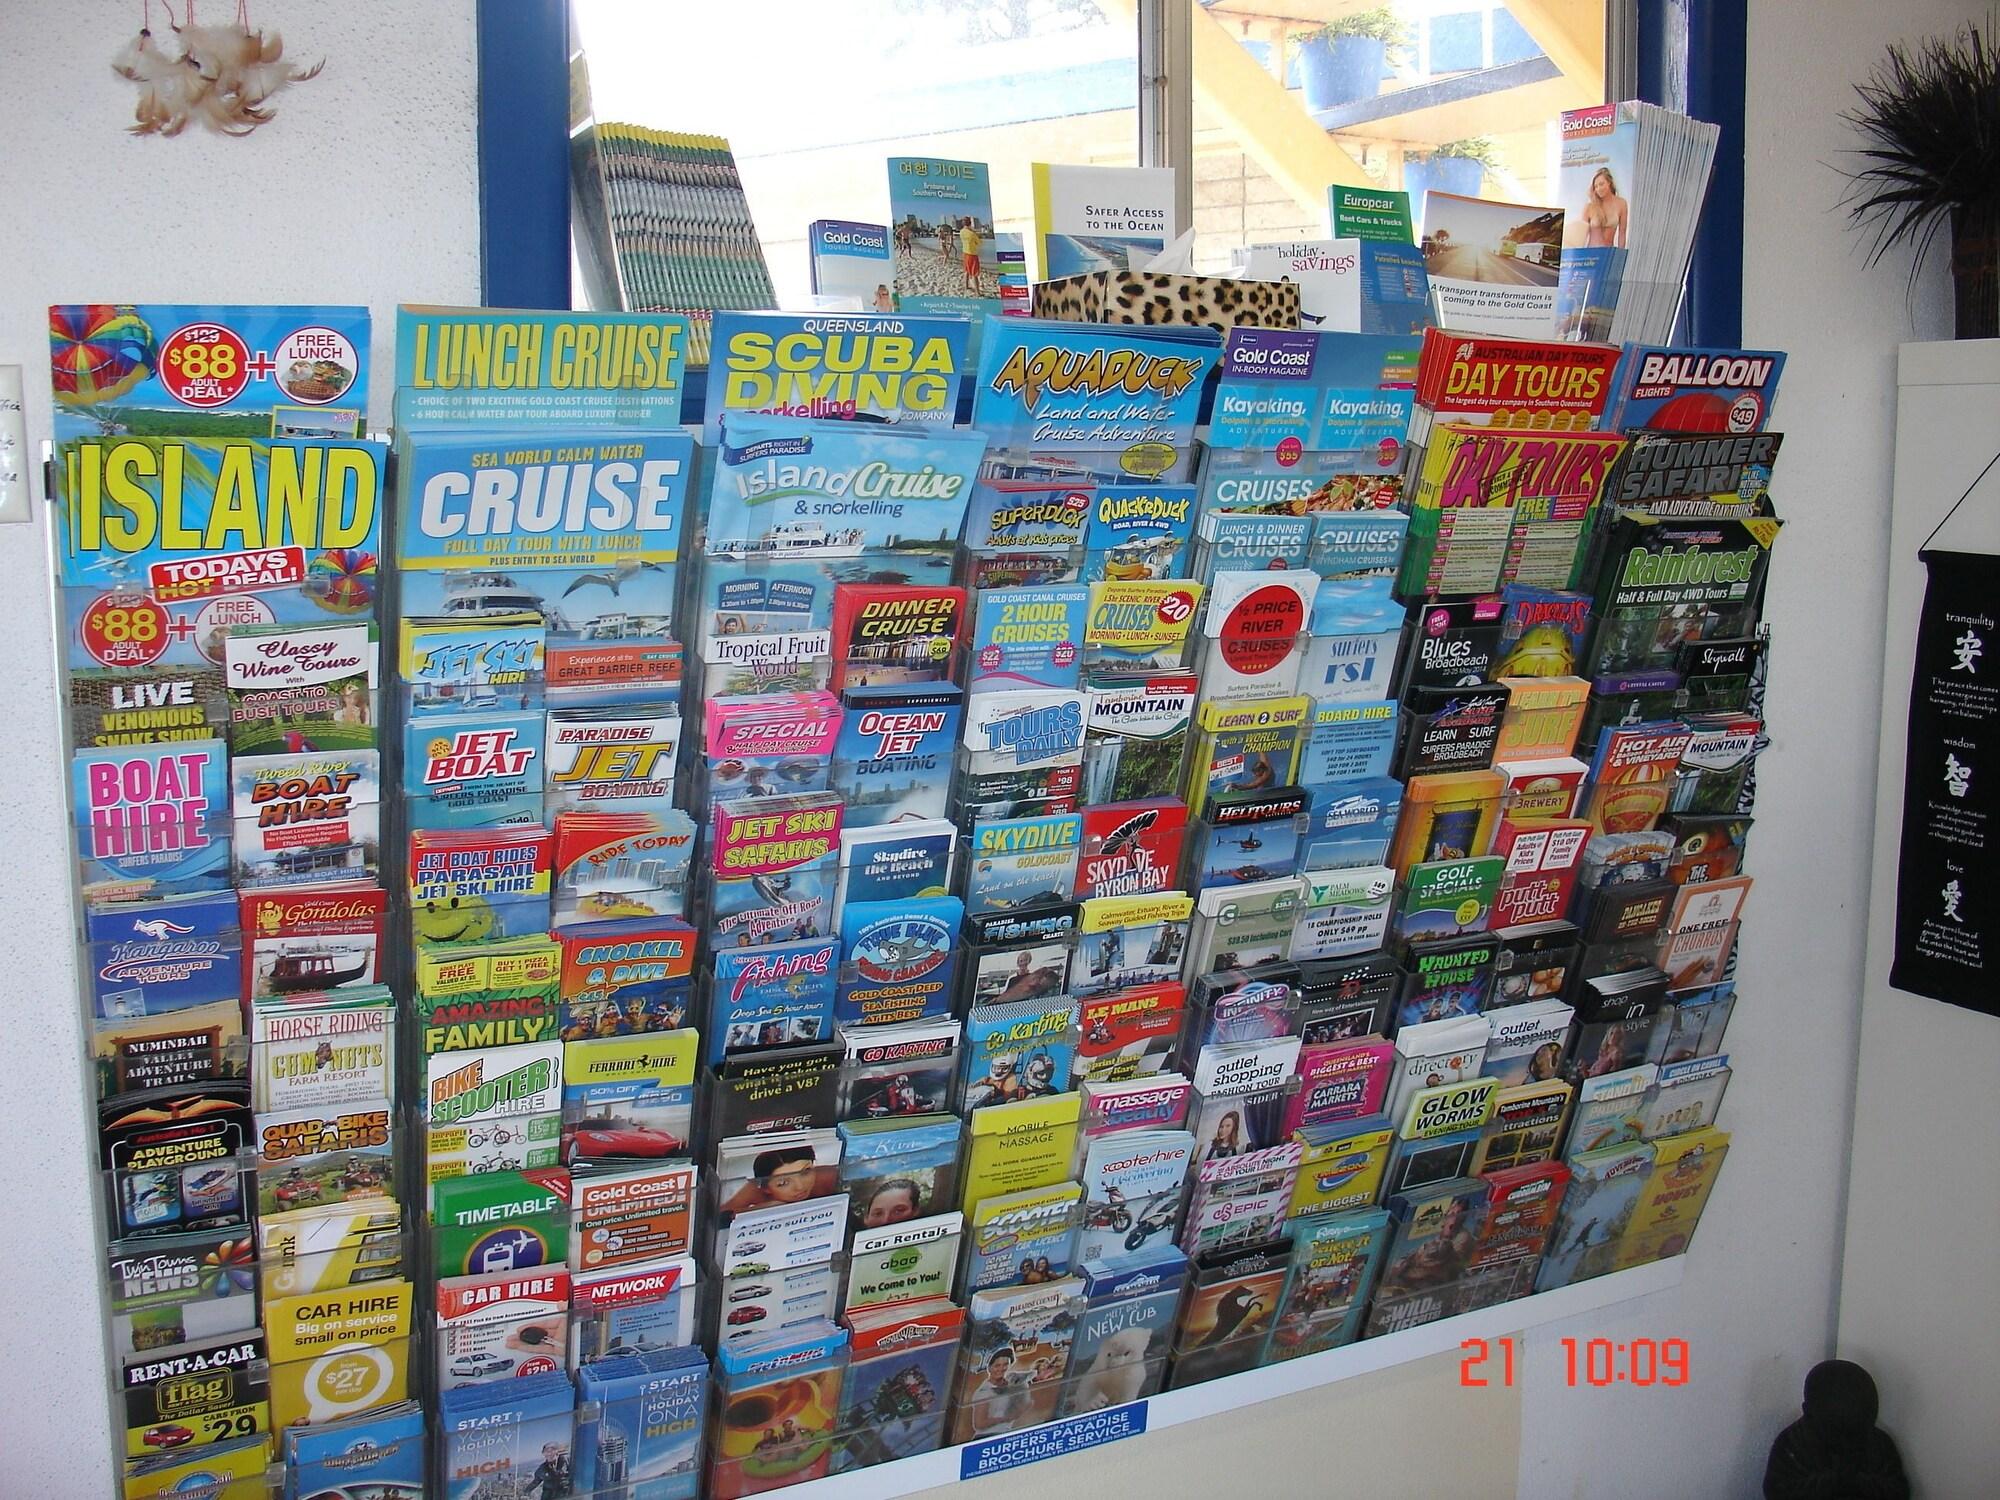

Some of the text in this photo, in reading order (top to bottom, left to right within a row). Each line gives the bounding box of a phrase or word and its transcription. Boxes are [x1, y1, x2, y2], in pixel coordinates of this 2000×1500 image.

[1561, 114, 1612, 132] Gold Coast
[900, 162, 976, 179] 여행 가이드
[1344, 194, 1394, 210] Europcar
[824, 232, 883, 248] Gold Coast
[1278, 245, 1318, 260] holiday
[1292, 252, 1355, 274] savings
[1430, 283, 1437, 291] A
[1439, 285, 1477, 299] transport
[1479, 288, 1541, 302] transformation
[1444, 296, 1474, 308] coming
[1488, 299, 1501, 307] the
[1504, 301, 1523, 309] Gold
[1525, 301, 1552, 310] Coast
[803, 320, 904, 333] QUEENSLAND
[296, 335, 336, 347] FREE
[170, 344, 236, 379] $88
[289, 347, 342, 359] LUNCH
[414, 323, 682, 390] LUNCH CRUISE
[726, 332, 954, 373] SCUBA
[1233, 348, 1310, 366] Gold Coast
[1446, 362, 1605, 399] DAY TOURS
[1640, 357, 1772, 387] BALLOON
[725, 372, 947, 410] DIVING
[1636, 387, 1671, 398] FLIGHTS
[1036, 404, 1175, 420] Land and Water
[1223, 396, 1306, 415] Kayaking,
[1032, 424, 1175, 442] Cruise Adventure
[1628, 437, 1775, 472] HUMMER
[1216, 480, 1313, 502] CRUISES
[1621, 465, 1741, 500] SAFARI
[79, 443, 376, 552] ISLAND
[421, 461, 680, 538] CRUISE
[794, 500, 903, 517] & snorkelling
[163, 550, 288, 581] TODAYS
[1622, 545, 1758, 587] Rainforest
[1617, 588, 1727, 604] Half & Full Day 4WD Tours
[862, 598, 956, 618] DINNER
[1003, 604, 1066, 623] 2 HOUR
[1094, 604, 1157, 630] CRUISES
[862, 617, 948, 636] CRUISE
[1241, 619, 1283, 634] RIVER
[1946, 612, 1995, 630] tranquility
[992, 624, 1069, 643] CRUISES
[257, 640, 338, 658] Classy
[716, 637, 826, 658] Tropical Fruit
[1421, 638, 1471, 659] Blues
[1951, 631, 1982, 673] 安
[233, 656, 361, 679] Wine Tours
[559, 663, 675, 678] GREAT BARRIER REEF
[1426, 654, 1488, 670] Broadbeach
[113, 681, 194, 708] LIVE
[1095, 700, 1184, 716] MOUNTAIN
[1317, 706, 1392, 723] BOARD HIRE
[102, 708, 204, 731] VENOMOUS
[859, 712, 945, 734] OCEAN
[985, 701, 1082, 749] TOURS
[559, 728, 652, 741] PARADISE
[733, 721, 829, 740] SPECIAL
[1424, 729, 1457, 742] LEARN
[1468, 726, 1496, 738] SURF
[450, 731, 514, 756] JET
[878, 735, 921, 758] JET
[1690, 740, 1748, 753] MOUNTAIN
[1943, 737, 1976, 750] wisdom
[554, 743, 674, 782] JET
[1434, 749, 1483, 761] BROADBEACH
[426, 751, 531, 782] BOAT
[1943, 752, 1971, 797] 智
[90, 754, 209, 807] BOAT
[251, 773, 360, 802] BOAT
[259, 796, 352, 827] HIRE
[92, 800, 210, 858] HIRE
[728, 810, 836, 842] JET SKI
[419, 847, 537, 868] JET BOAT RIDES
[1946, 861, 1964, 874] love
[418, 864, 535, 885] PARASAIL
[1436, 865, 1474, 882] GOLF
[286, 900, 376, 921] Gondolas
[577, 942, 684, 965] SNORKEL
[1419, 950, 1489, 973] HAUNTED
[1424, 968, 1476, 989] HOUSE
[270, 1012, 383, 1040] HORSE RIDING
[426, 1017, 545, 1052] FAMILY
[129, 1035, 207, 1054] NUMINBAH
[864, 1040, 947, 1061] GO KARTING
[1213, 1062, 1284, 1087] shopping
[1217, 1055, 1258, 1075] outlet
[1099, 1087, 1184, 1109] massage
[1310, 1092, 1358, 1109] MARKETS
[1313, 1082, 1361, 1100] CARRARA
[1422, 1085, 1493, 1114] GLOW
[1416, 1104, 1485, 1131] WORMS
[127, 1147, 227, 1171] PLAYGROUND
[133, 1138, 222, 1159] ADVENTURE
[1101, 1149, 1184, 1174] scooterhire
[456, 1196, 557, 1226] TIMETABLE
[1235, 1200, 1268, 1215] EPIC
[865, 1226, 948, 1250] Car Rentals
[462, 1278, 554, 1305] CAR HIRE
[592, 1276, 666, 1299] NETWORK
[295, 1296, 399, 1320] CAR HIRE
[295, 1313, 398, 1334] Big on service
[295, 1325, 396, 1345] small on price
[130, 1344, 256, 1384] RENT-A-CAR
[979, 1422, 1130, 1469] BROCHURE SERVICE
[982, 1412, 1129, 1458] SURFERS PARADISE
